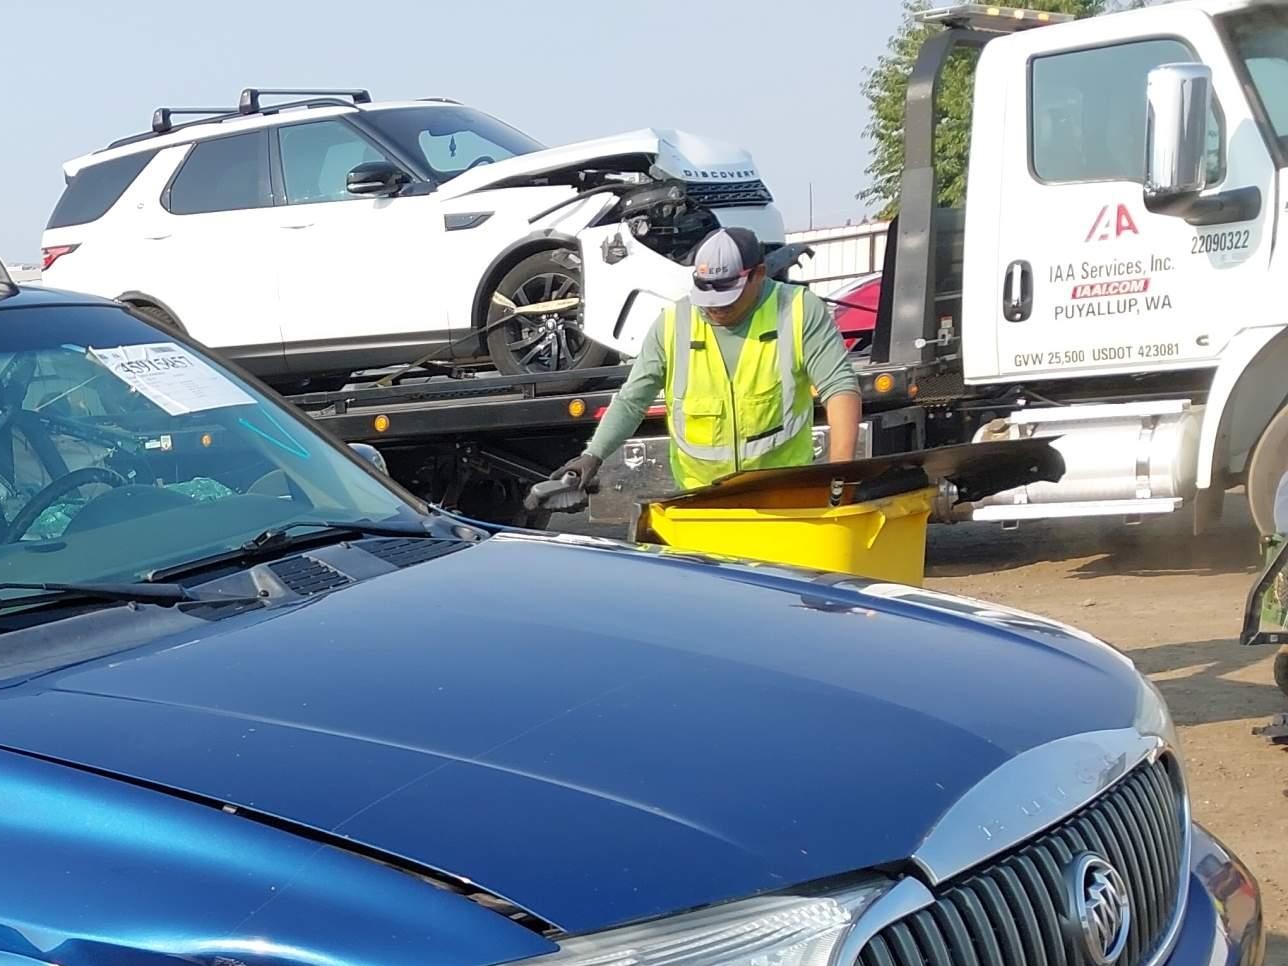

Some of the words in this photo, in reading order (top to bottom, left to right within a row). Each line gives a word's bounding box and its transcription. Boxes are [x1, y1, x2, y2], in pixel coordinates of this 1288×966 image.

[683, 169, 755, 179] DISCOVERY
[1190, 229, 1251, 255] 22090322
[1049, 263, 1076, 283] IAA
[1081, 258, 1147, 280] Services,
[1150, 253, 1175, 273] Inc.
[1054, 299, 1141, 321] PUYALLUP,
[1144, 294, 1172, 312] WA
[1014, 352, 1044, 367] GVW
[1048, 350, 1085, 366] 25,500
[1092, 346, 1134, 361] USDOT
[1137, 343, 1180, 357] 423081
